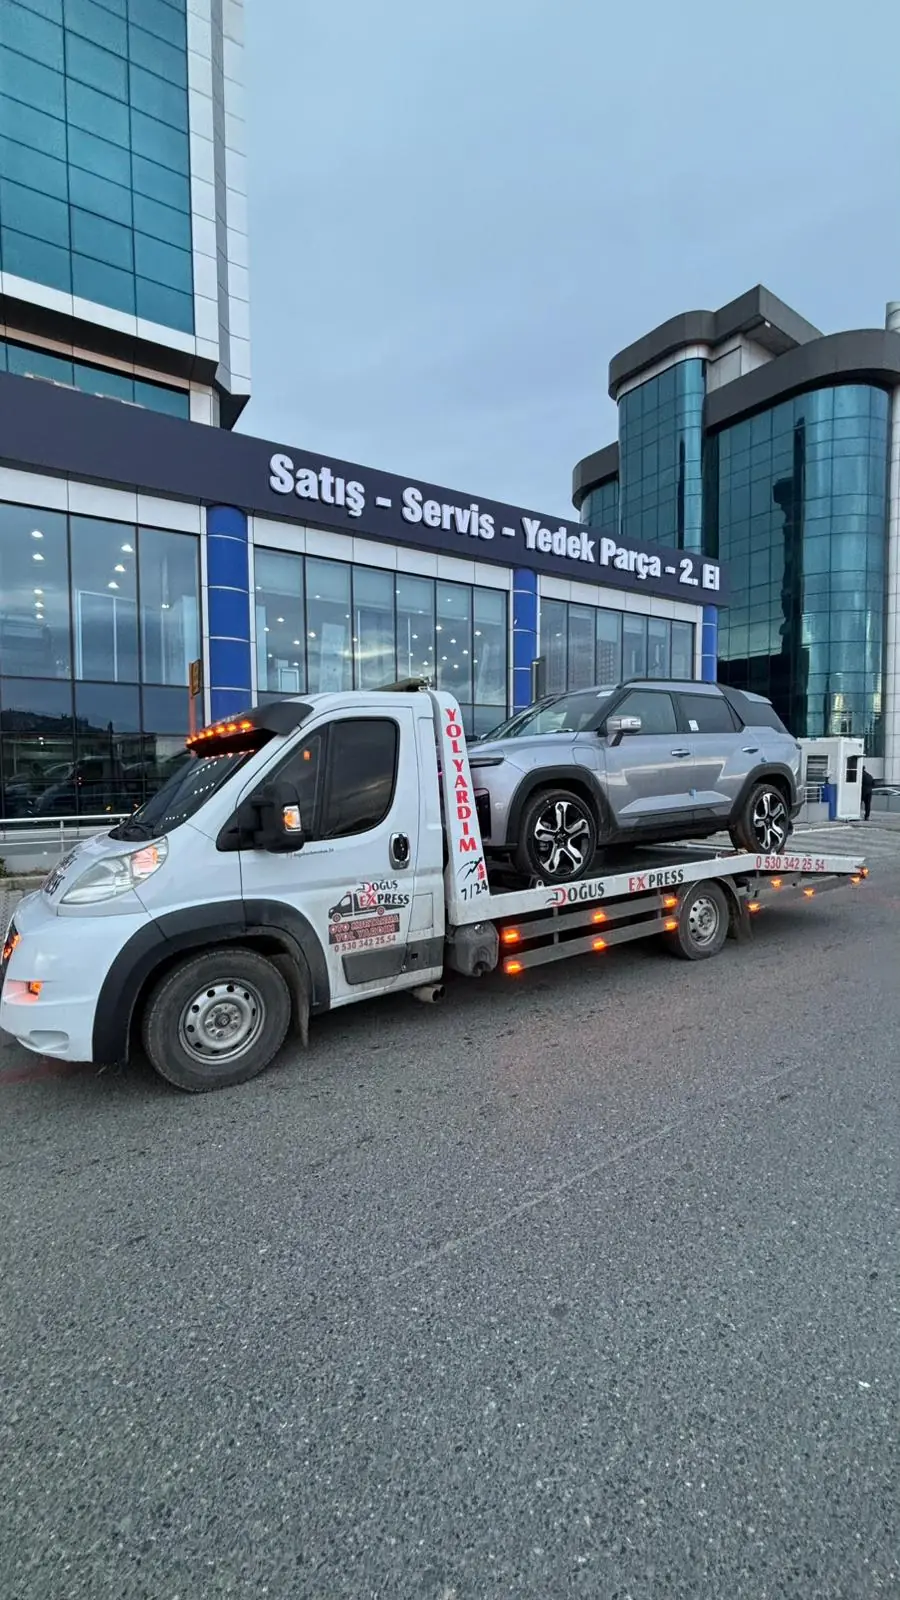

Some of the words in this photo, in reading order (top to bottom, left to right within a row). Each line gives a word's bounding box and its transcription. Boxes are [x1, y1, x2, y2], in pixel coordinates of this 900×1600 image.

[269, 453, 366, 517] Satış
[401, 486, 496, 540] Servis
[522, 517, 595, 563] Yedek
[599, 537, 661, 579] Parça
[679, 558, 699, 586] 2.
[702, 563, 720, 591] El
[445, 708, 463, 754] YOL
[452, 759, 477, 853] YARDIM
[756, 855, 762, 869] 0
[764, 856, 781, 869] 530
[783, 857, 799, 870] 342
[802, 858, 812, 870] 25
[815, 859, 825, 871] 54
[461, 880, 489, 901] 7/24
[628, 868, 684, 893] EXPRESS
[360, 893, 410, 906] EXPRESS
[341, 941, 357, 951] 530
[360, 938, 373, 948] 342
